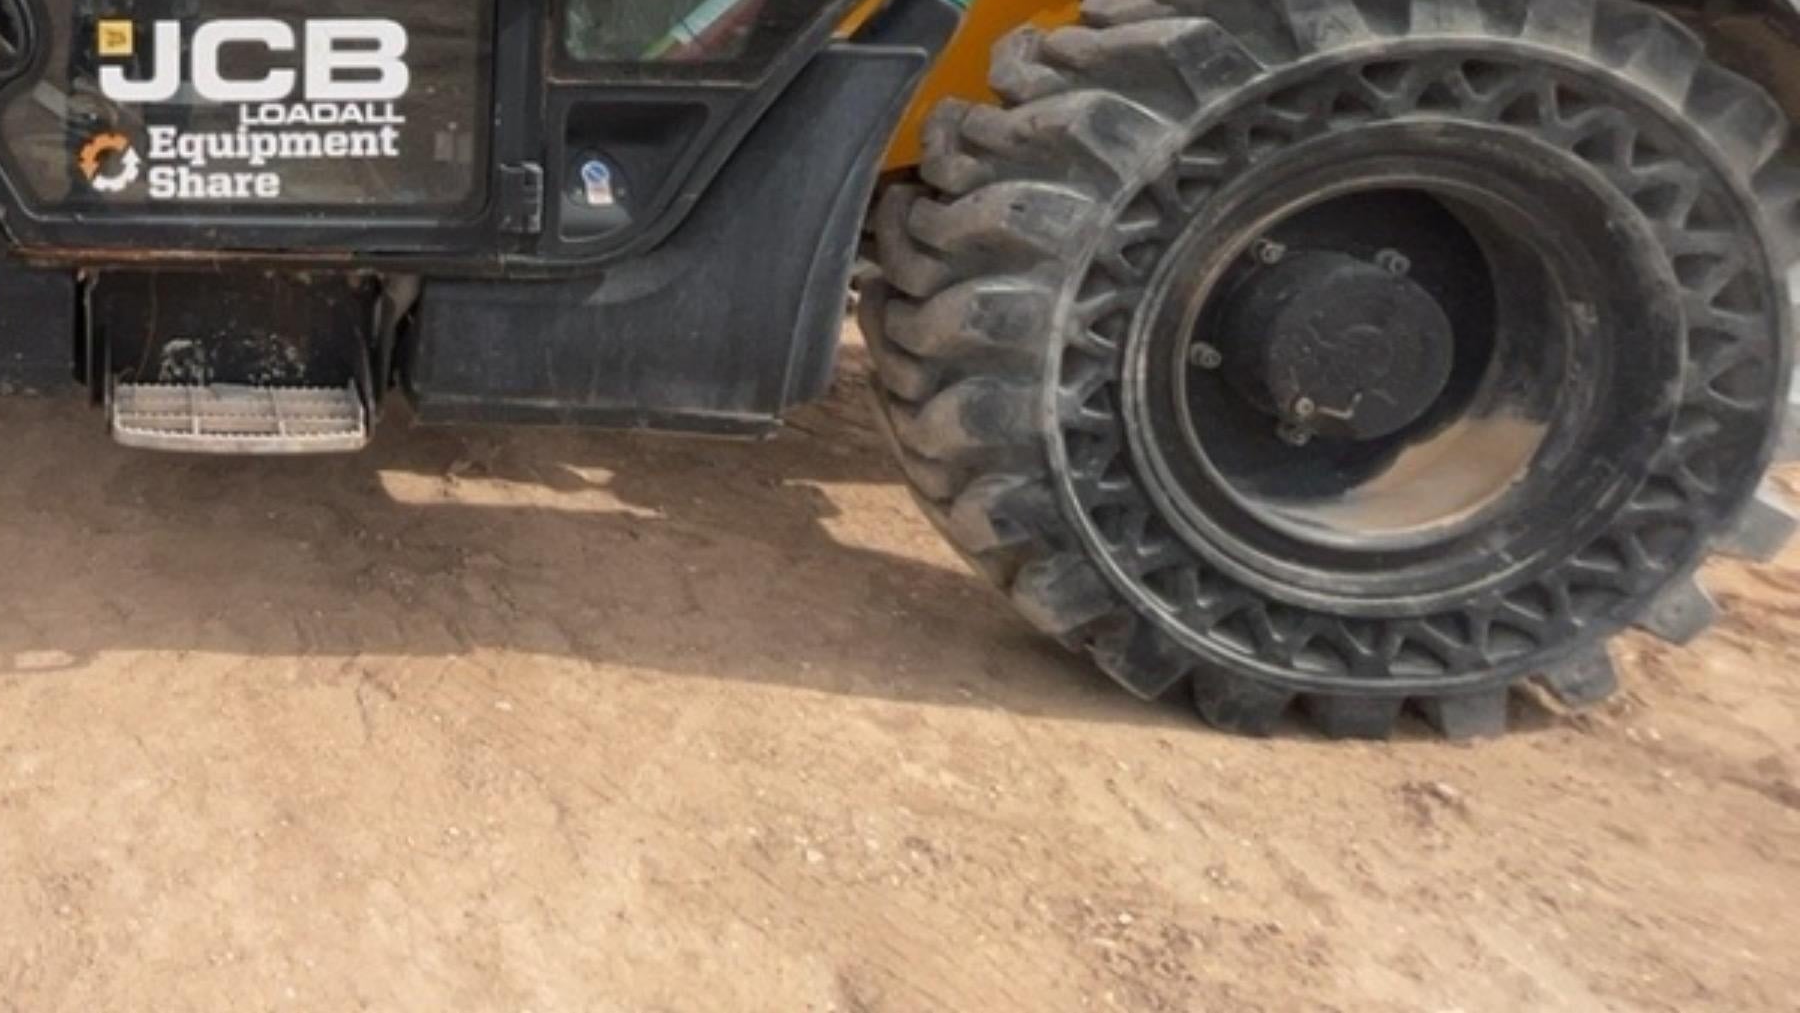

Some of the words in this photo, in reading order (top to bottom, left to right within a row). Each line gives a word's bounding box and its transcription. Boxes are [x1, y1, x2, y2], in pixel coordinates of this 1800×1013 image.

[98, 18, 410, 103] JCB
[239, 103, 406, 125] LOADALL
[147, 125, 400, 165] Equipment
[147, 166, 281, 199] Share
